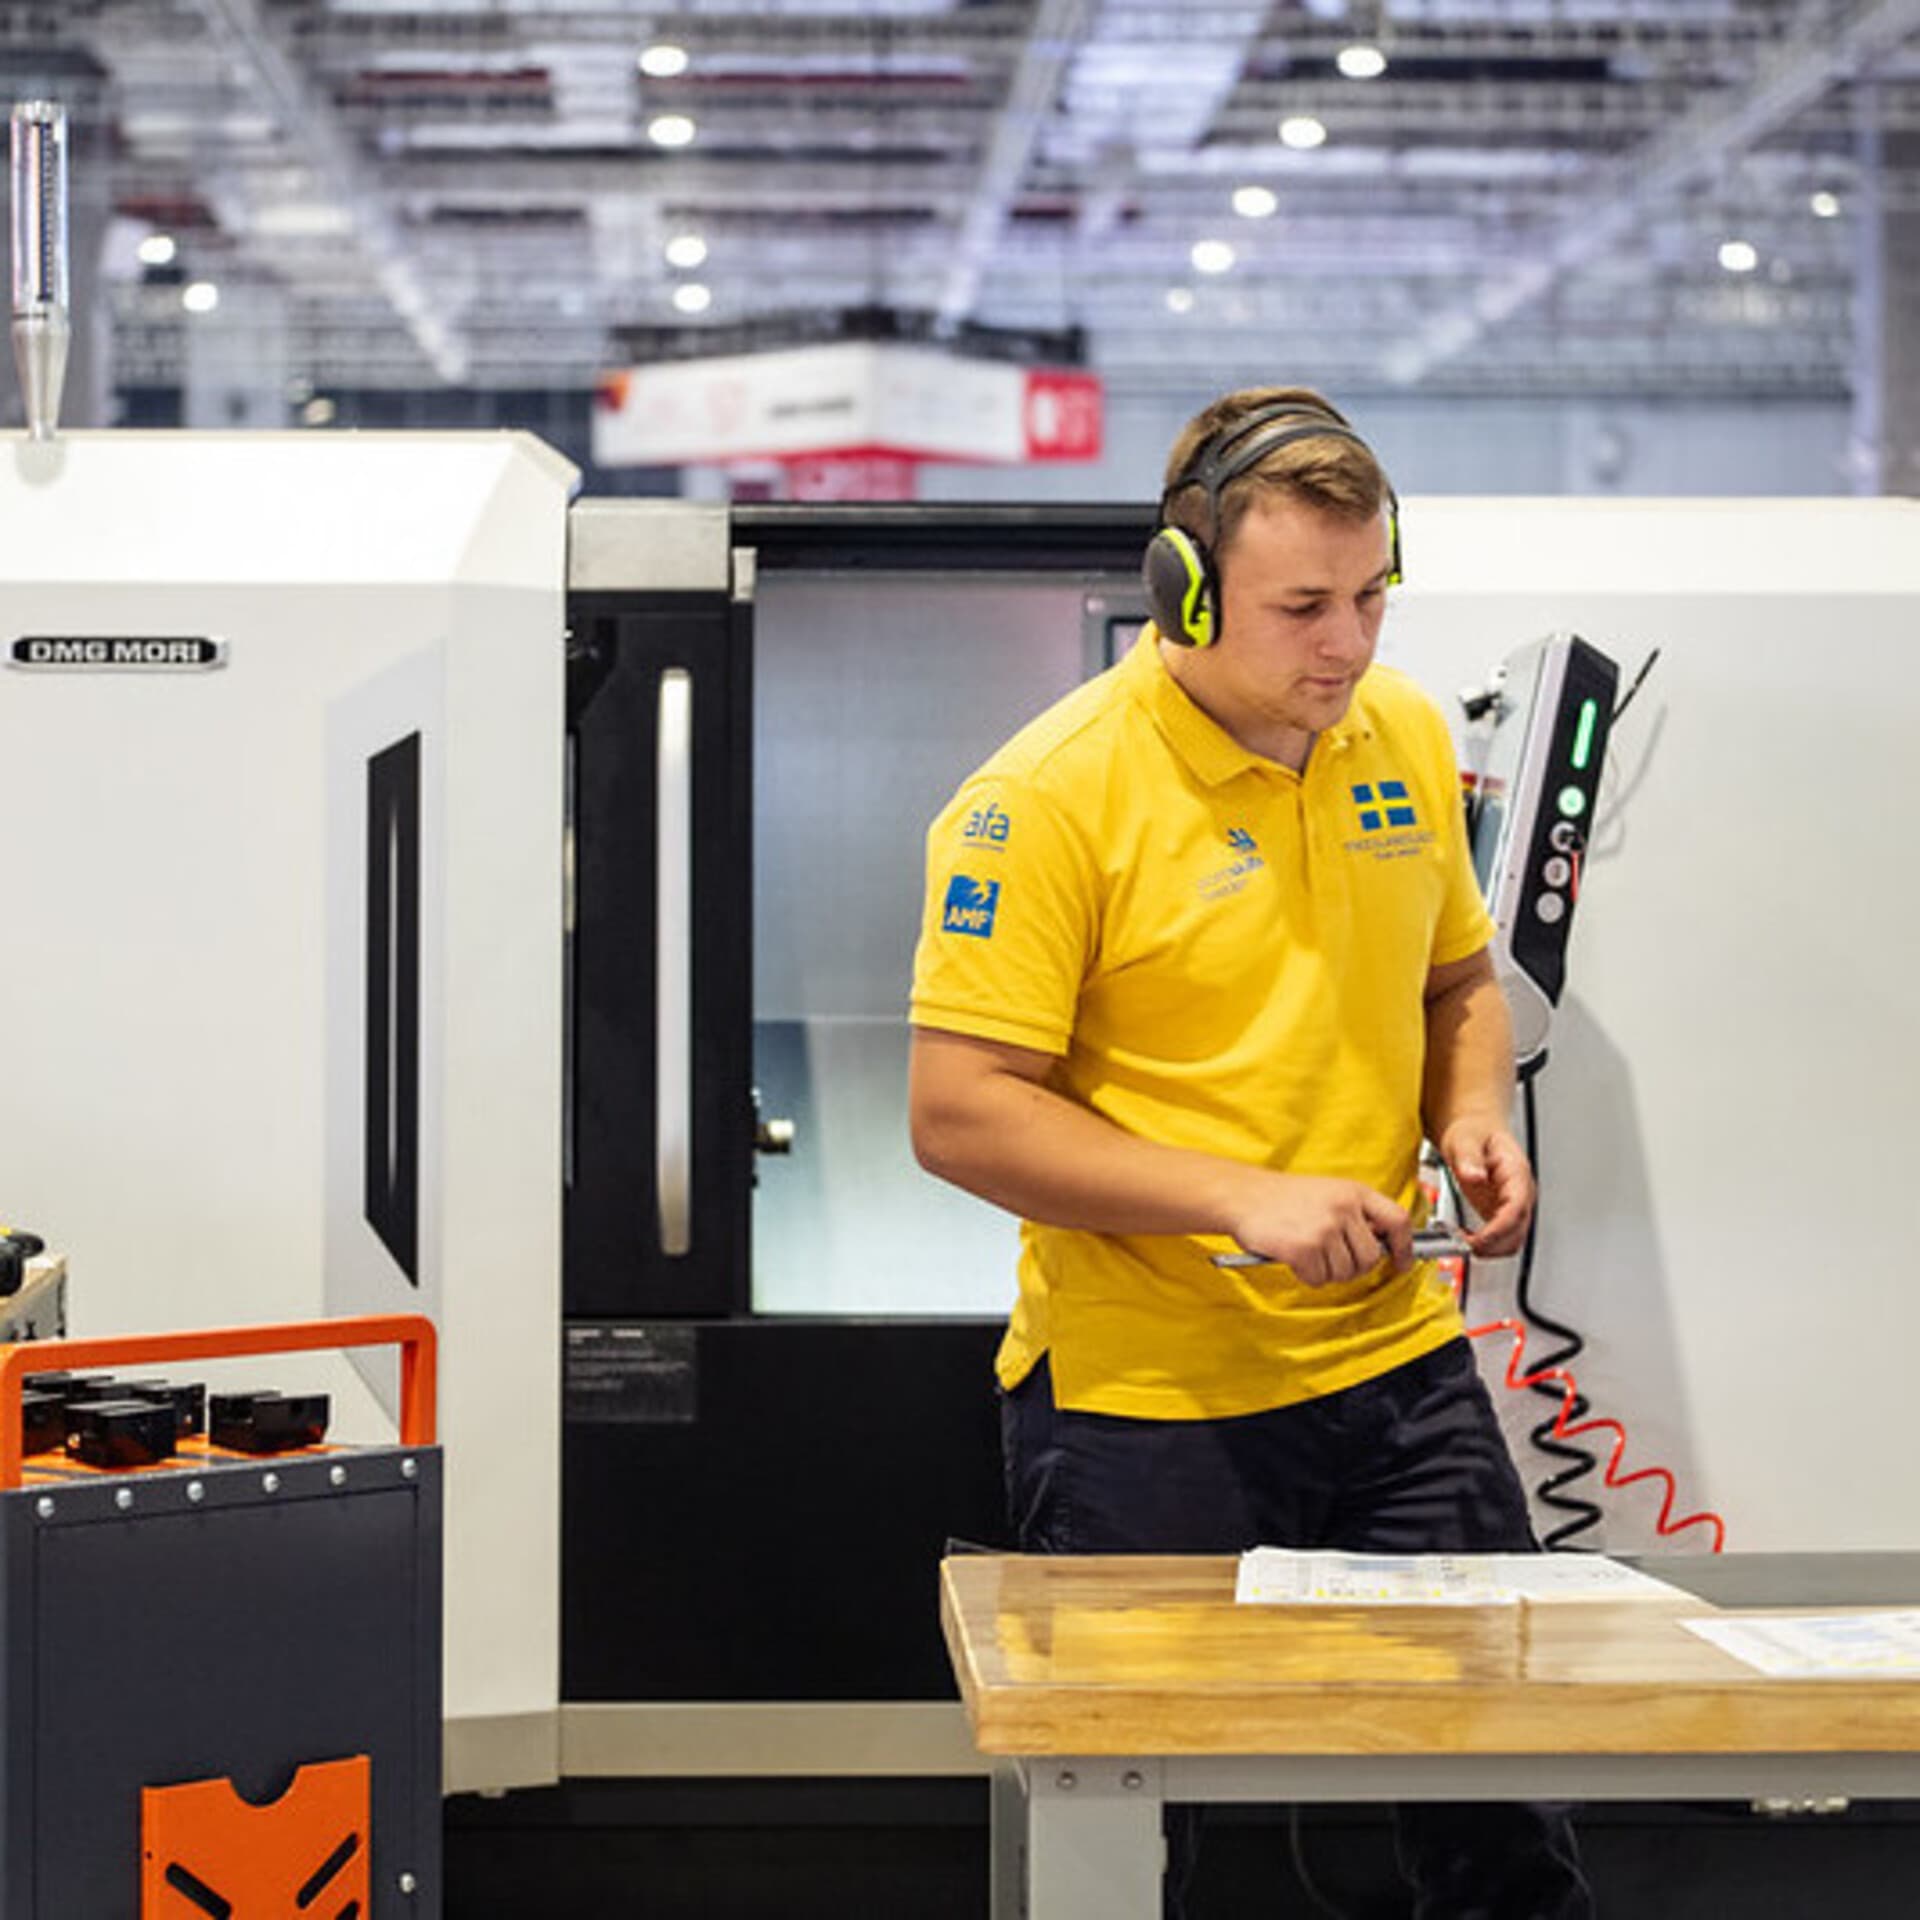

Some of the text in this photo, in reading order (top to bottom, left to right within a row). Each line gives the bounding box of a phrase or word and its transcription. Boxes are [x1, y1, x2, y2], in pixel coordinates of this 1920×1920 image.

[30, 641, 199, 662] DMG MORI
[964, 803, 1009, 841] afa
